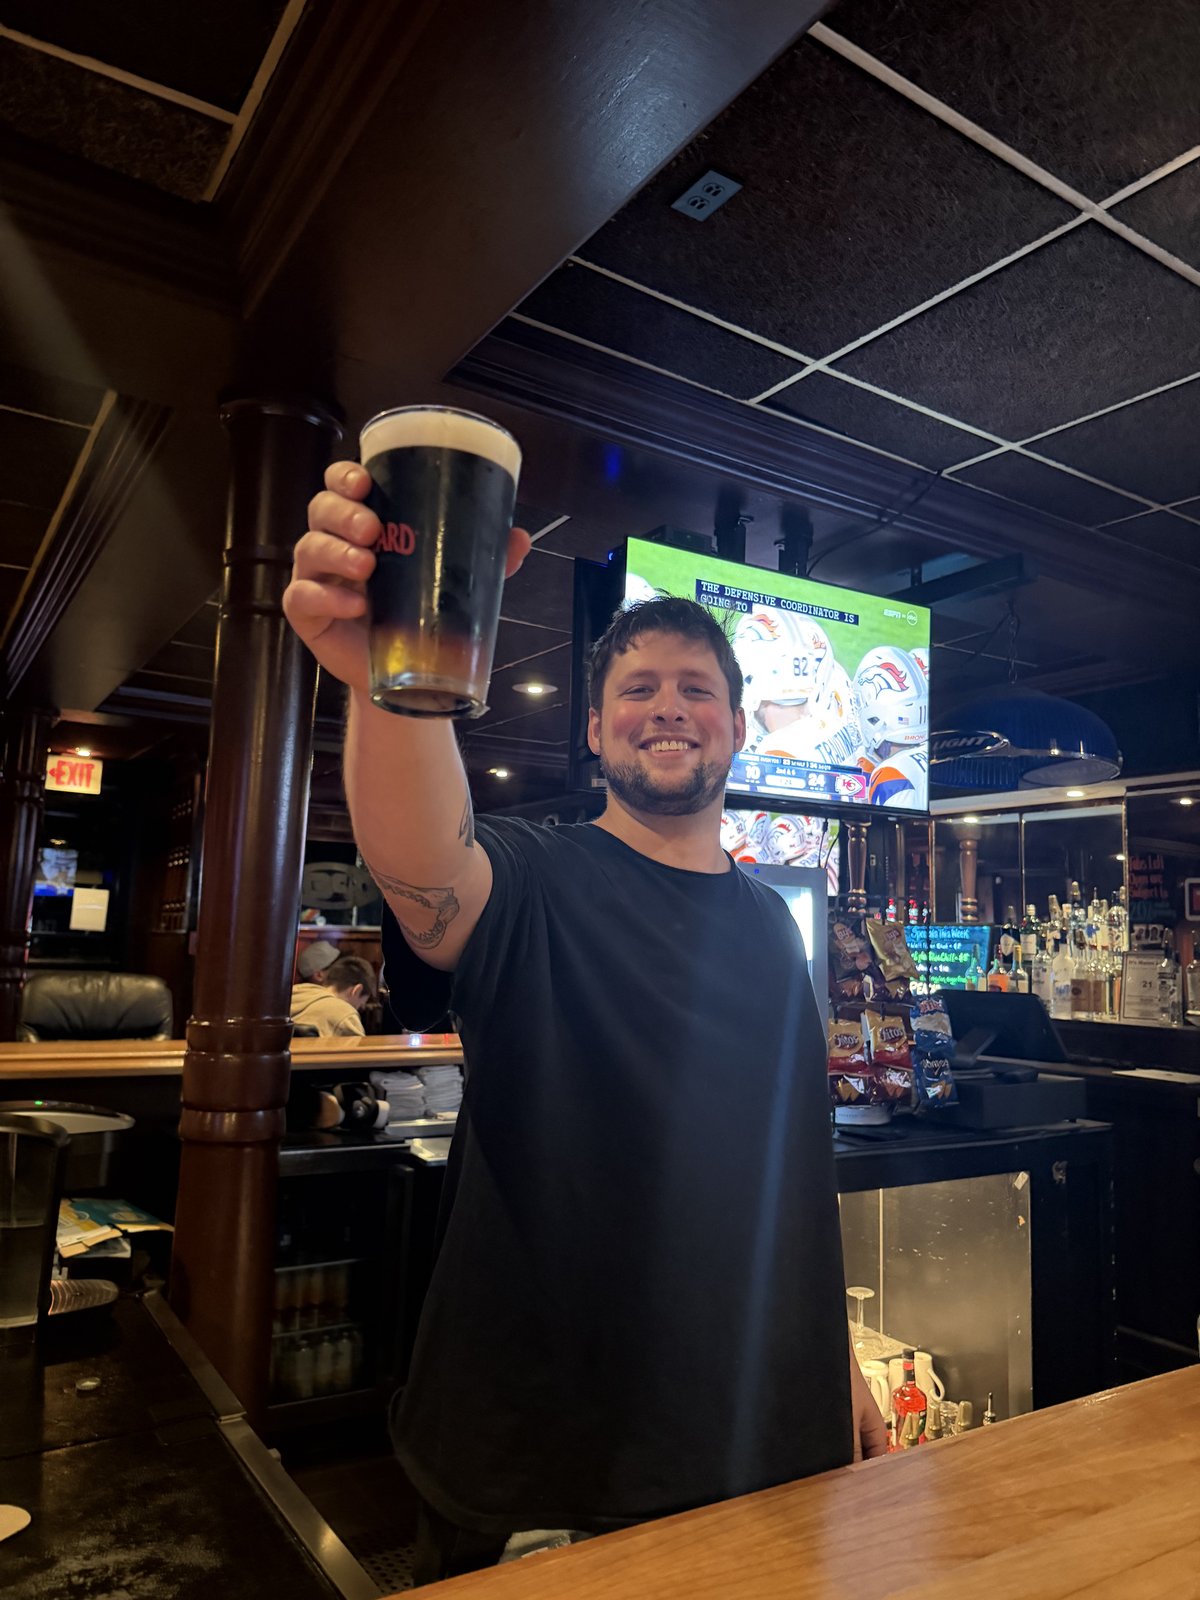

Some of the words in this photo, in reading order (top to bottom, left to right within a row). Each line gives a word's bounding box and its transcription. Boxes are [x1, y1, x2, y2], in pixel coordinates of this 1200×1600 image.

[700, 594, 730, 608] GOING
[736, 601, 748, 612] TO
[701, 582, 720, 594] THE
[724, 586, 776, 606] DEFENSIVE
[780, 600, 840, 621] COORDINATOR
[844, 613, 855, 623] IS
[793, 656, 809, 677] 82
[56, 760, 95, 788] EXIT
[745, 765, 761, 780] 10
[808, 773, 825, 788] 24
